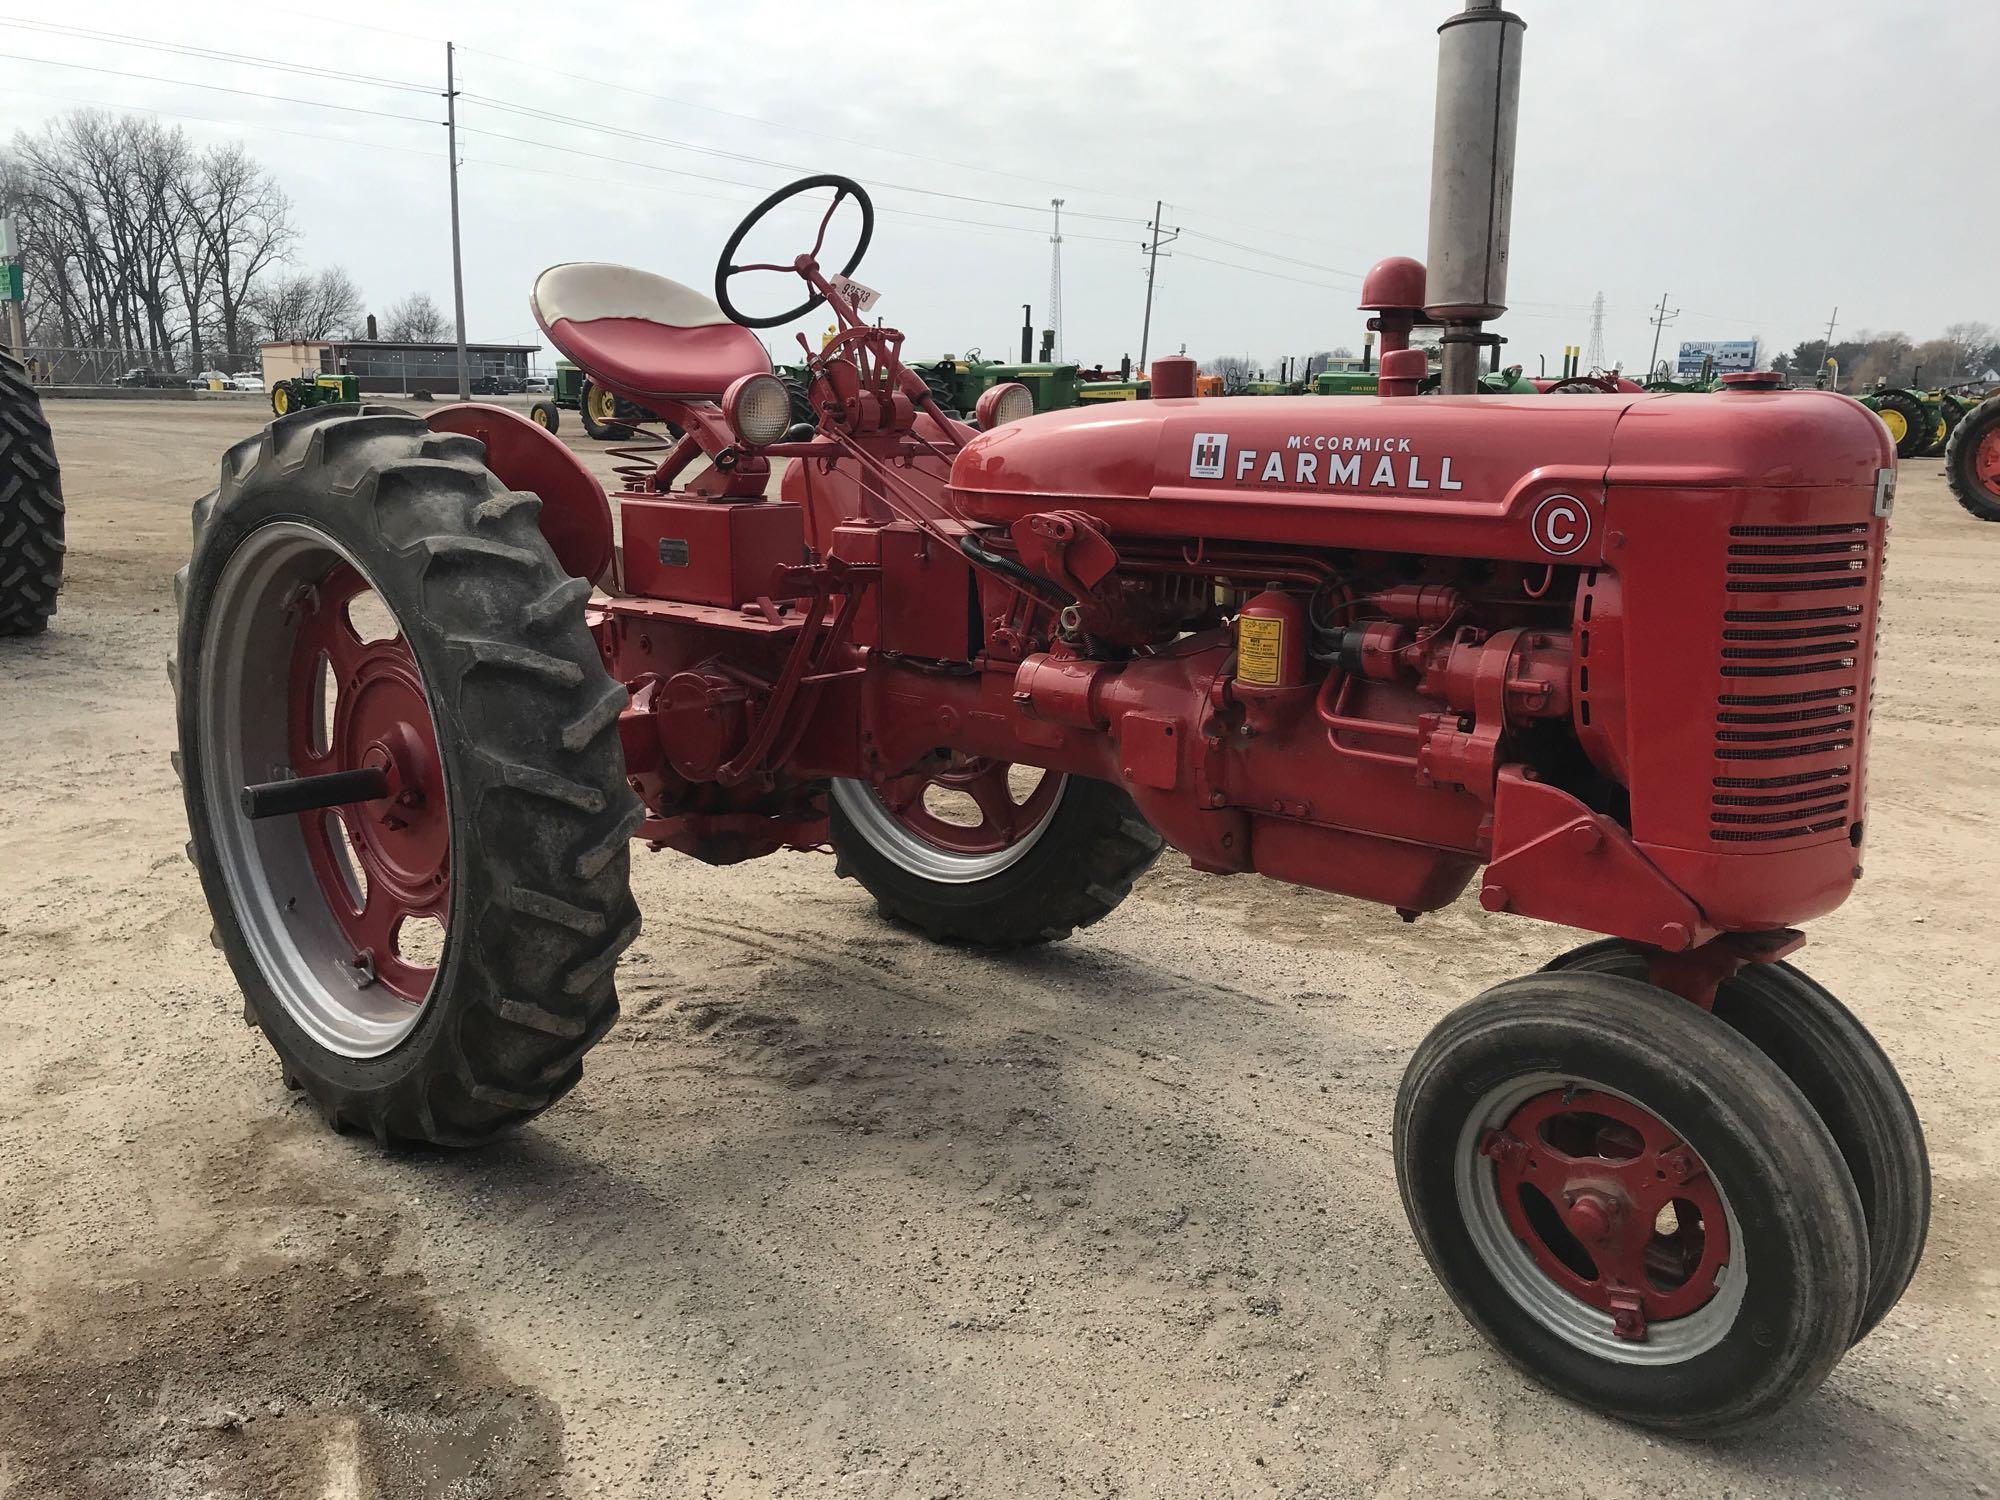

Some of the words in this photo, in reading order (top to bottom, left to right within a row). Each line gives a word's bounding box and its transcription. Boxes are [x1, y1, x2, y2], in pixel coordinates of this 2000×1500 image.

[1683, 342, 1716, 352] Quality
[1236, 450, 1463, 491] FARMALL
[1547, 507, 1576, 545] C
